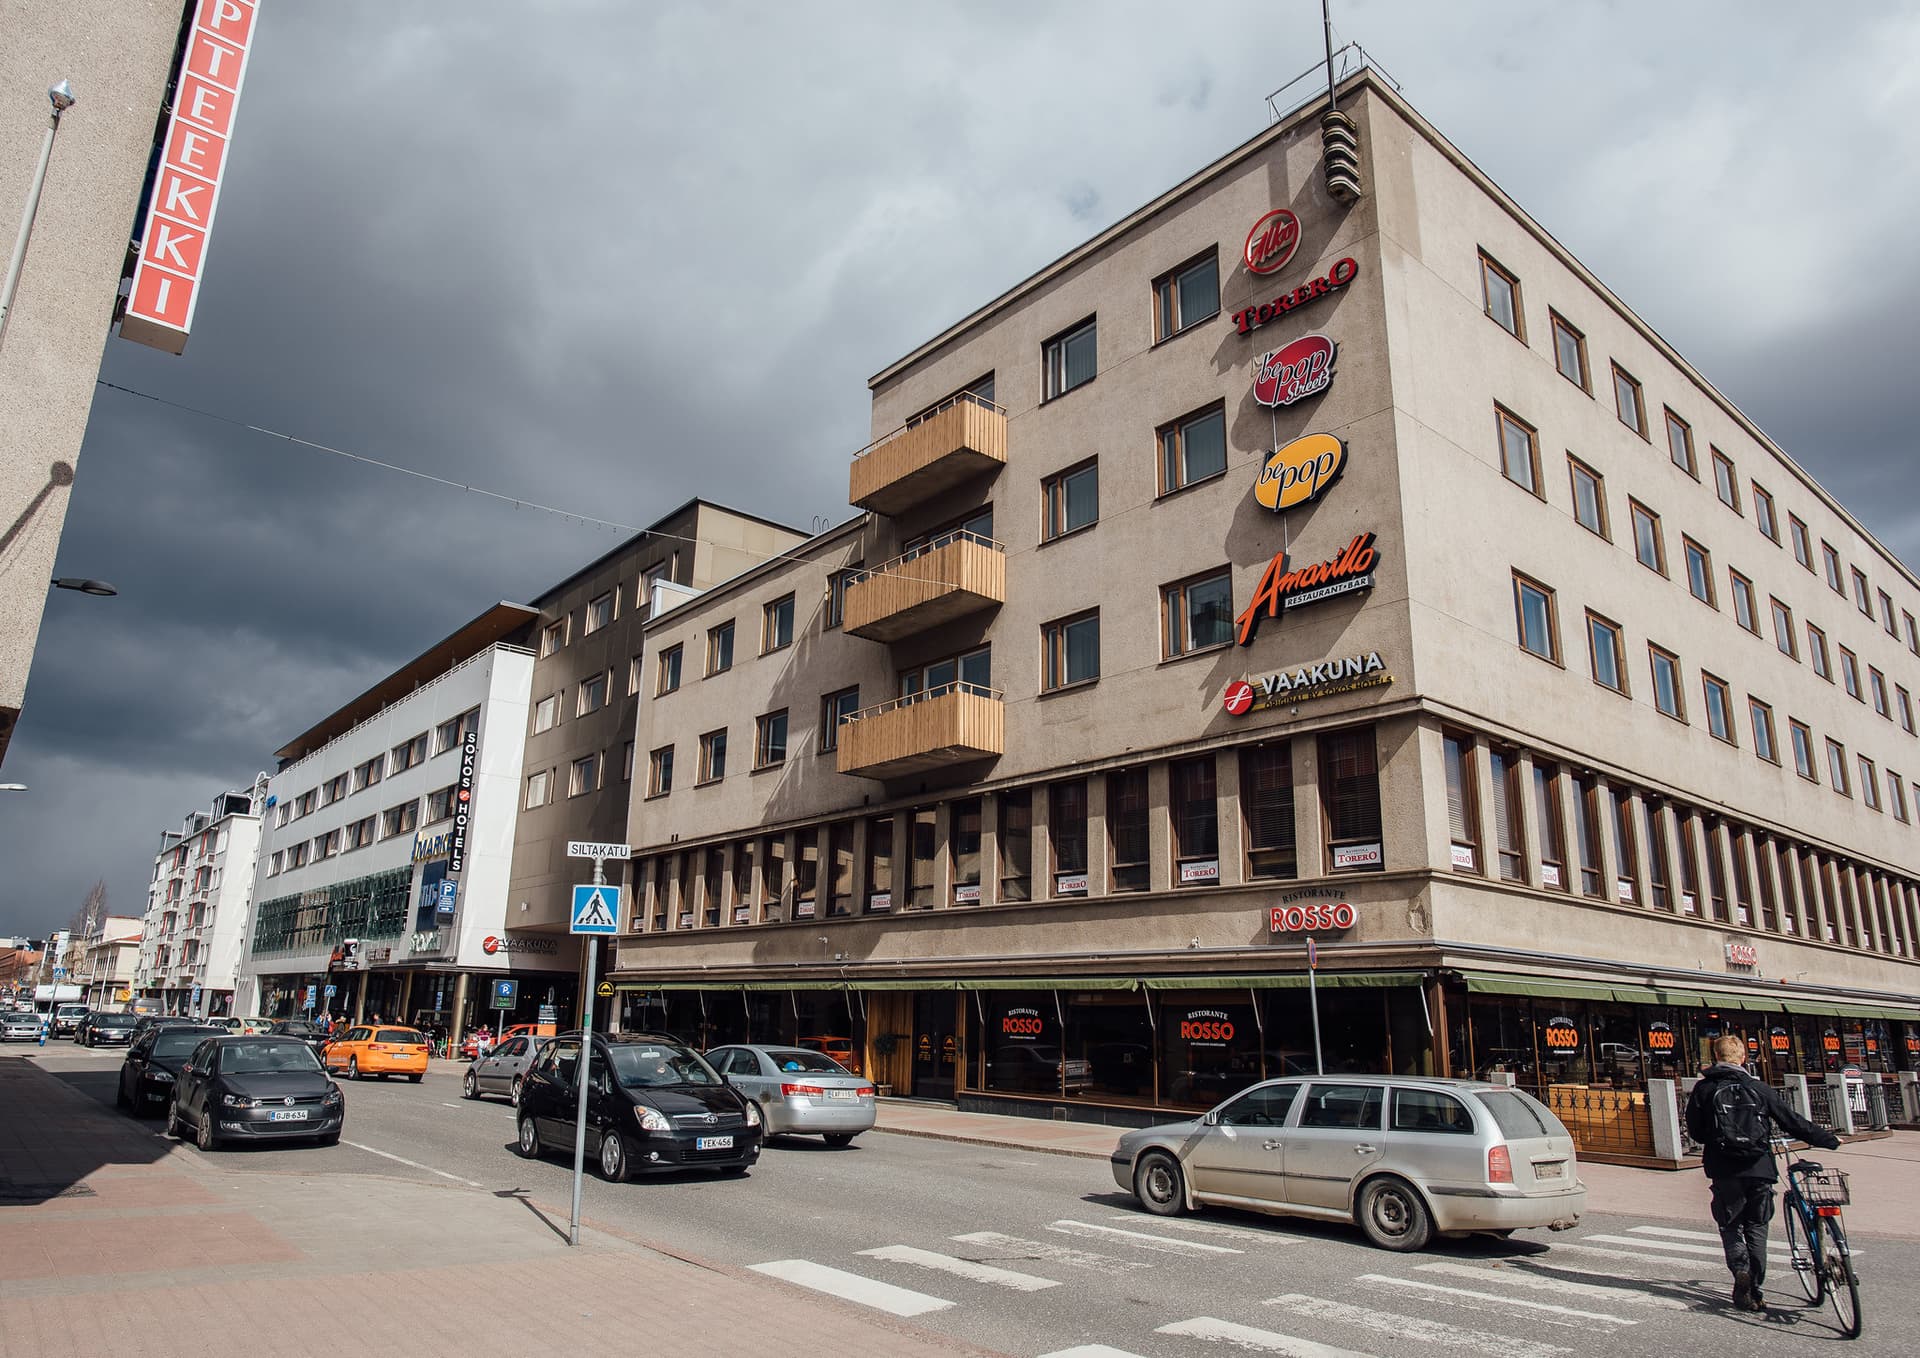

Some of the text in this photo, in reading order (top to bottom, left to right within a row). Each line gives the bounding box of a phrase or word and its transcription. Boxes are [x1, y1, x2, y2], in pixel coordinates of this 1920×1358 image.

[1249, 220, 1296, 268] Alko
[1231, 257, 1359, 335] TORERO
[1286, 370, 1329, 402] Street
[1236, 532, 1378, 647] Amarillo
[1261, 652, 1385, 695] VAAKUNA
[1264, 675, 1394, 709] ORIGINAL BY SOKOS HOTELS
[462, 733, 476, 788] SOKOS
[452, 804, 469, 871] HOTELS
[571, 843, 628, 857] SILTAKATU
[1338, 851, 1377, 863] TORERO
[1184, 867, 1216, 878] TORERO
[1282, 887, 1347, 904] RISTORANTE
[1270, 902, 1357, 932] ROSSO
[501, 936, 558, 949] VAAKUNA
[1008, 1007, 1039, 1017] RISTORANTE
[1187, 1010, 1229, 1020] RISTORANTE
[1002, 1017, 1043, 1034] ROSSO
[1181, 1021, 1235, 1040] ROSSO
[1546, 1028, 1579, 1047] ROSSO
[1648, 1032, 1674, 1048] ROSSO
[276, 1112, 306, 1120] GJB-634
[703, 1138, 732, 1148] YEK-456
